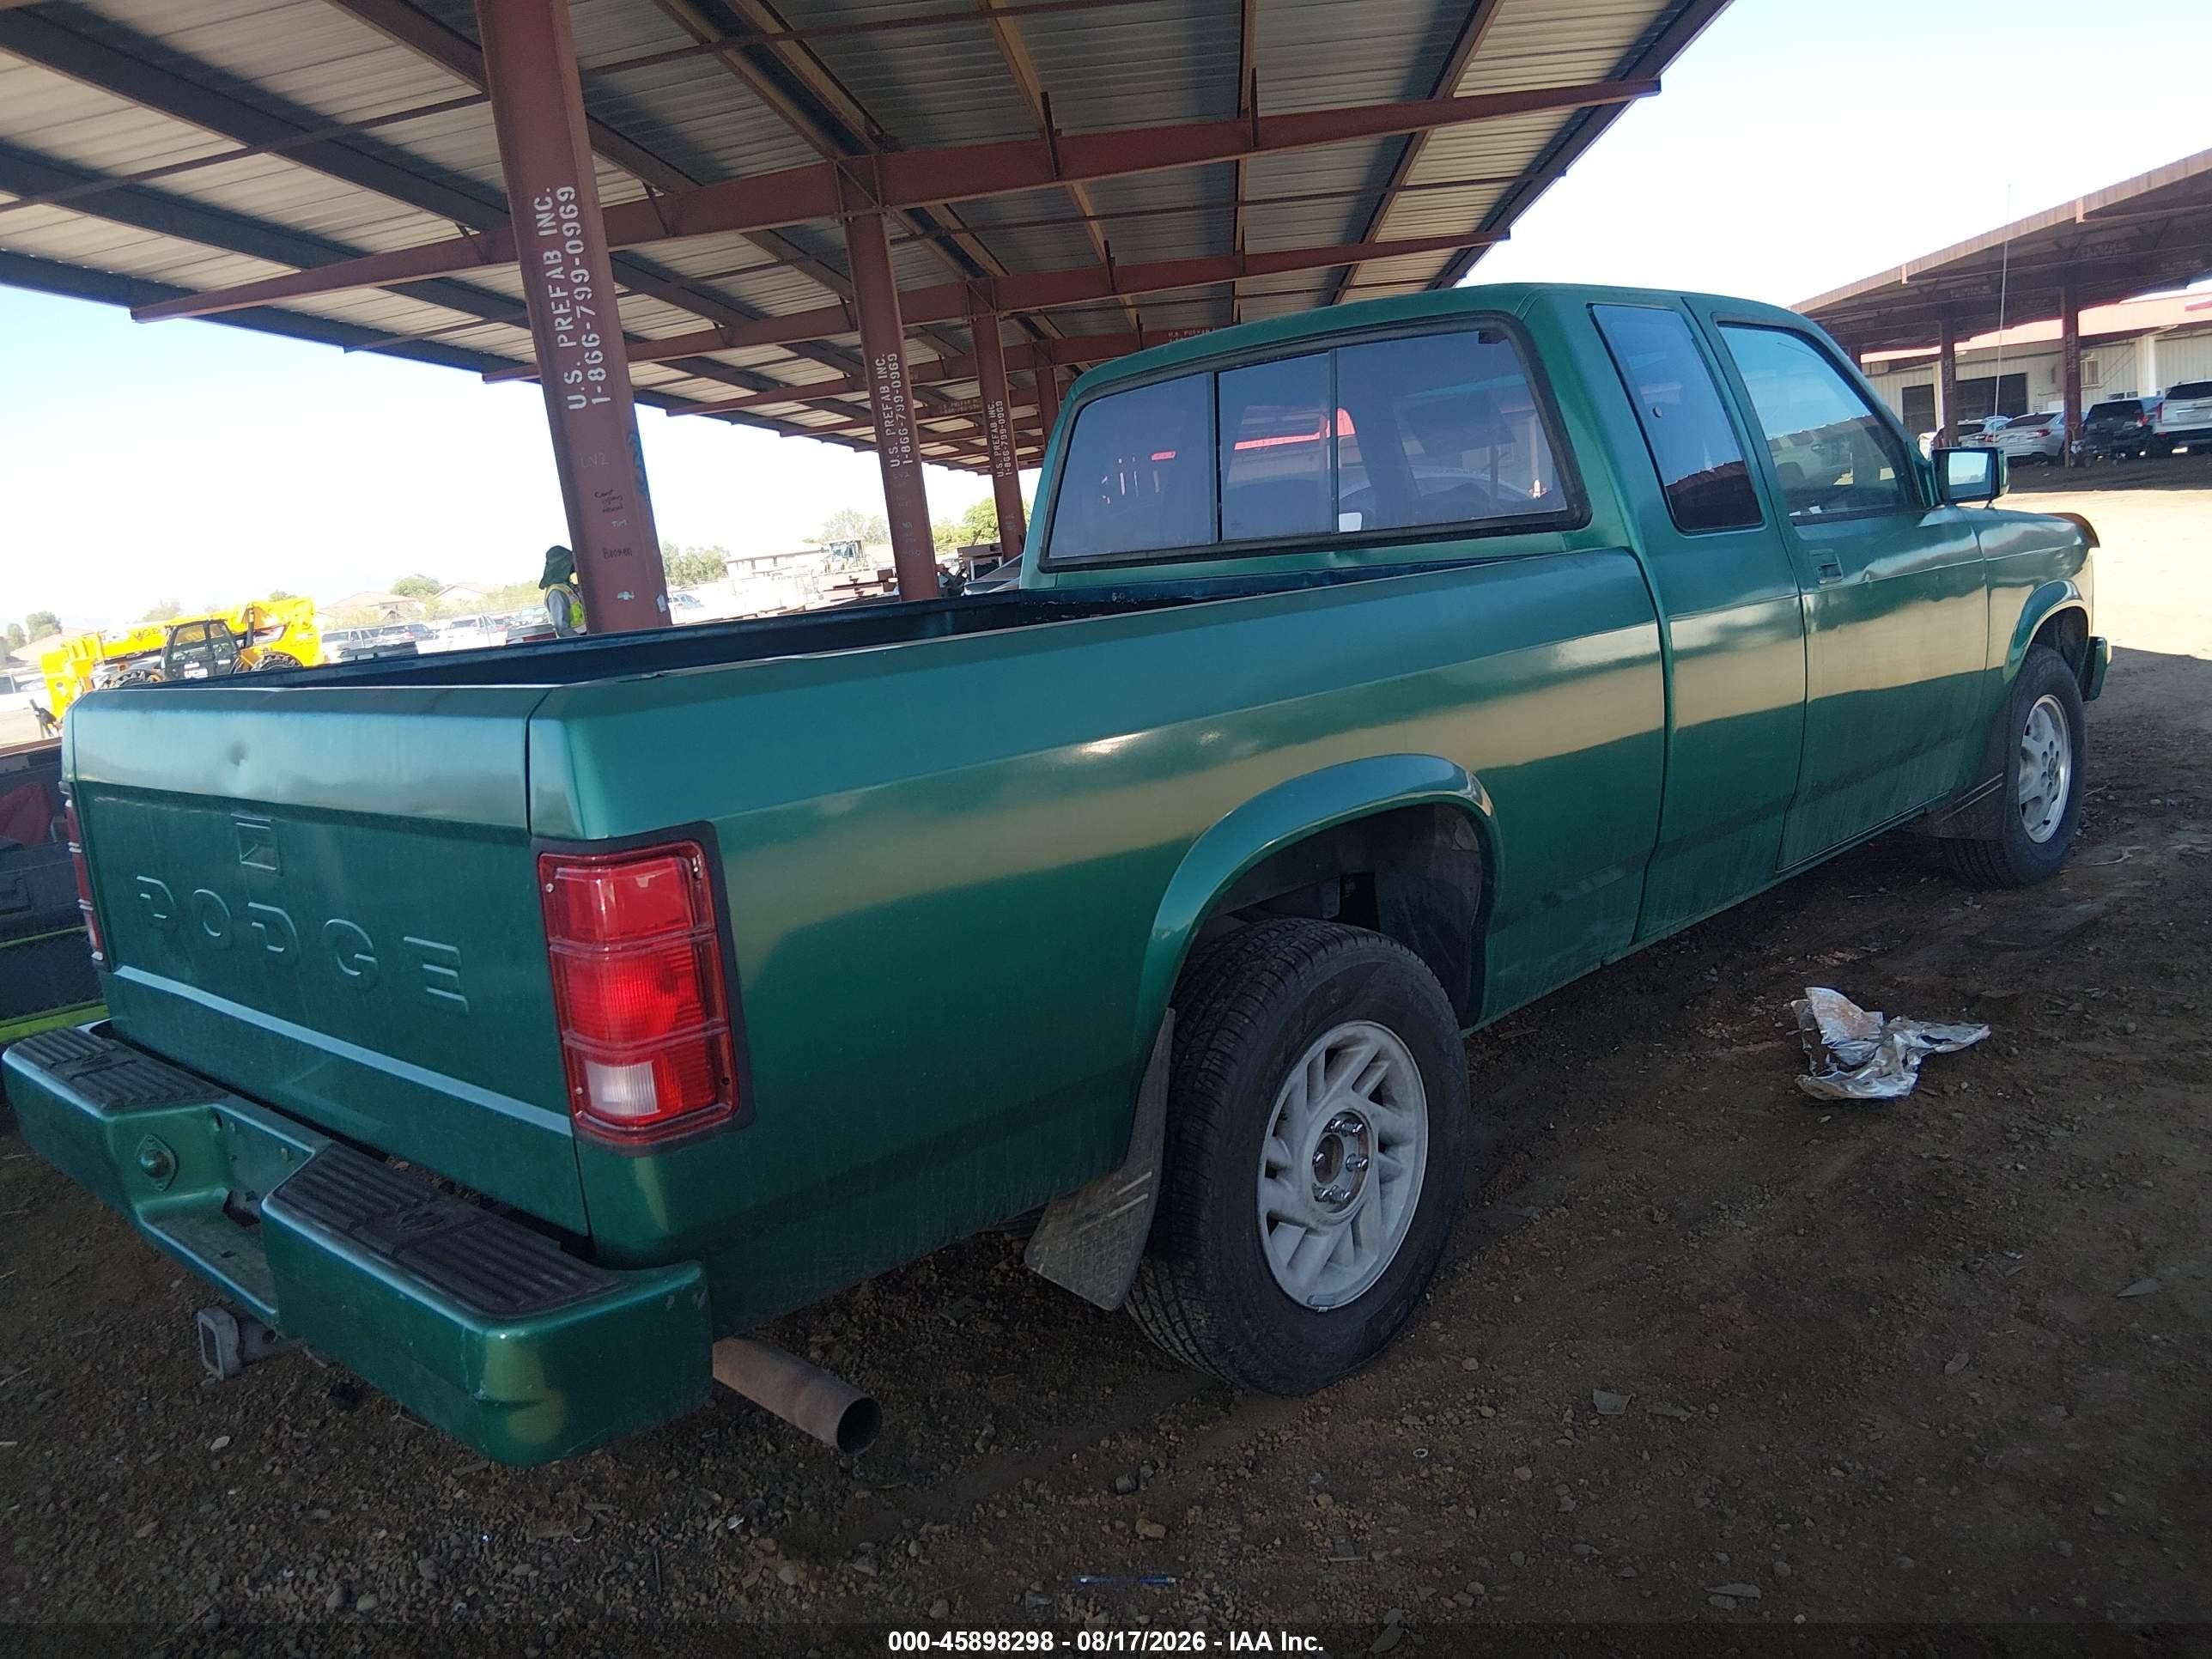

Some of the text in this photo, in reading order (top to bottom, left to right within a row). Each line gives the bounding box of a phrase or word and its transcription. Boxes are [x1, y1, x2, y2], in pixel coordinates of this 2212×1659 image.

[533, 186, 588, 410] U.S. PREFAB INC.
[556, 185, 611, 404] 1-866-799-0969
[874, 353, 901, 467] U.S. PREFAB INC.
[888, 353, 914, 465] 1-866-799-0969
[989, 422, 1002, 457] PREFAB
[136, 873, 470, 1017] DODGE
